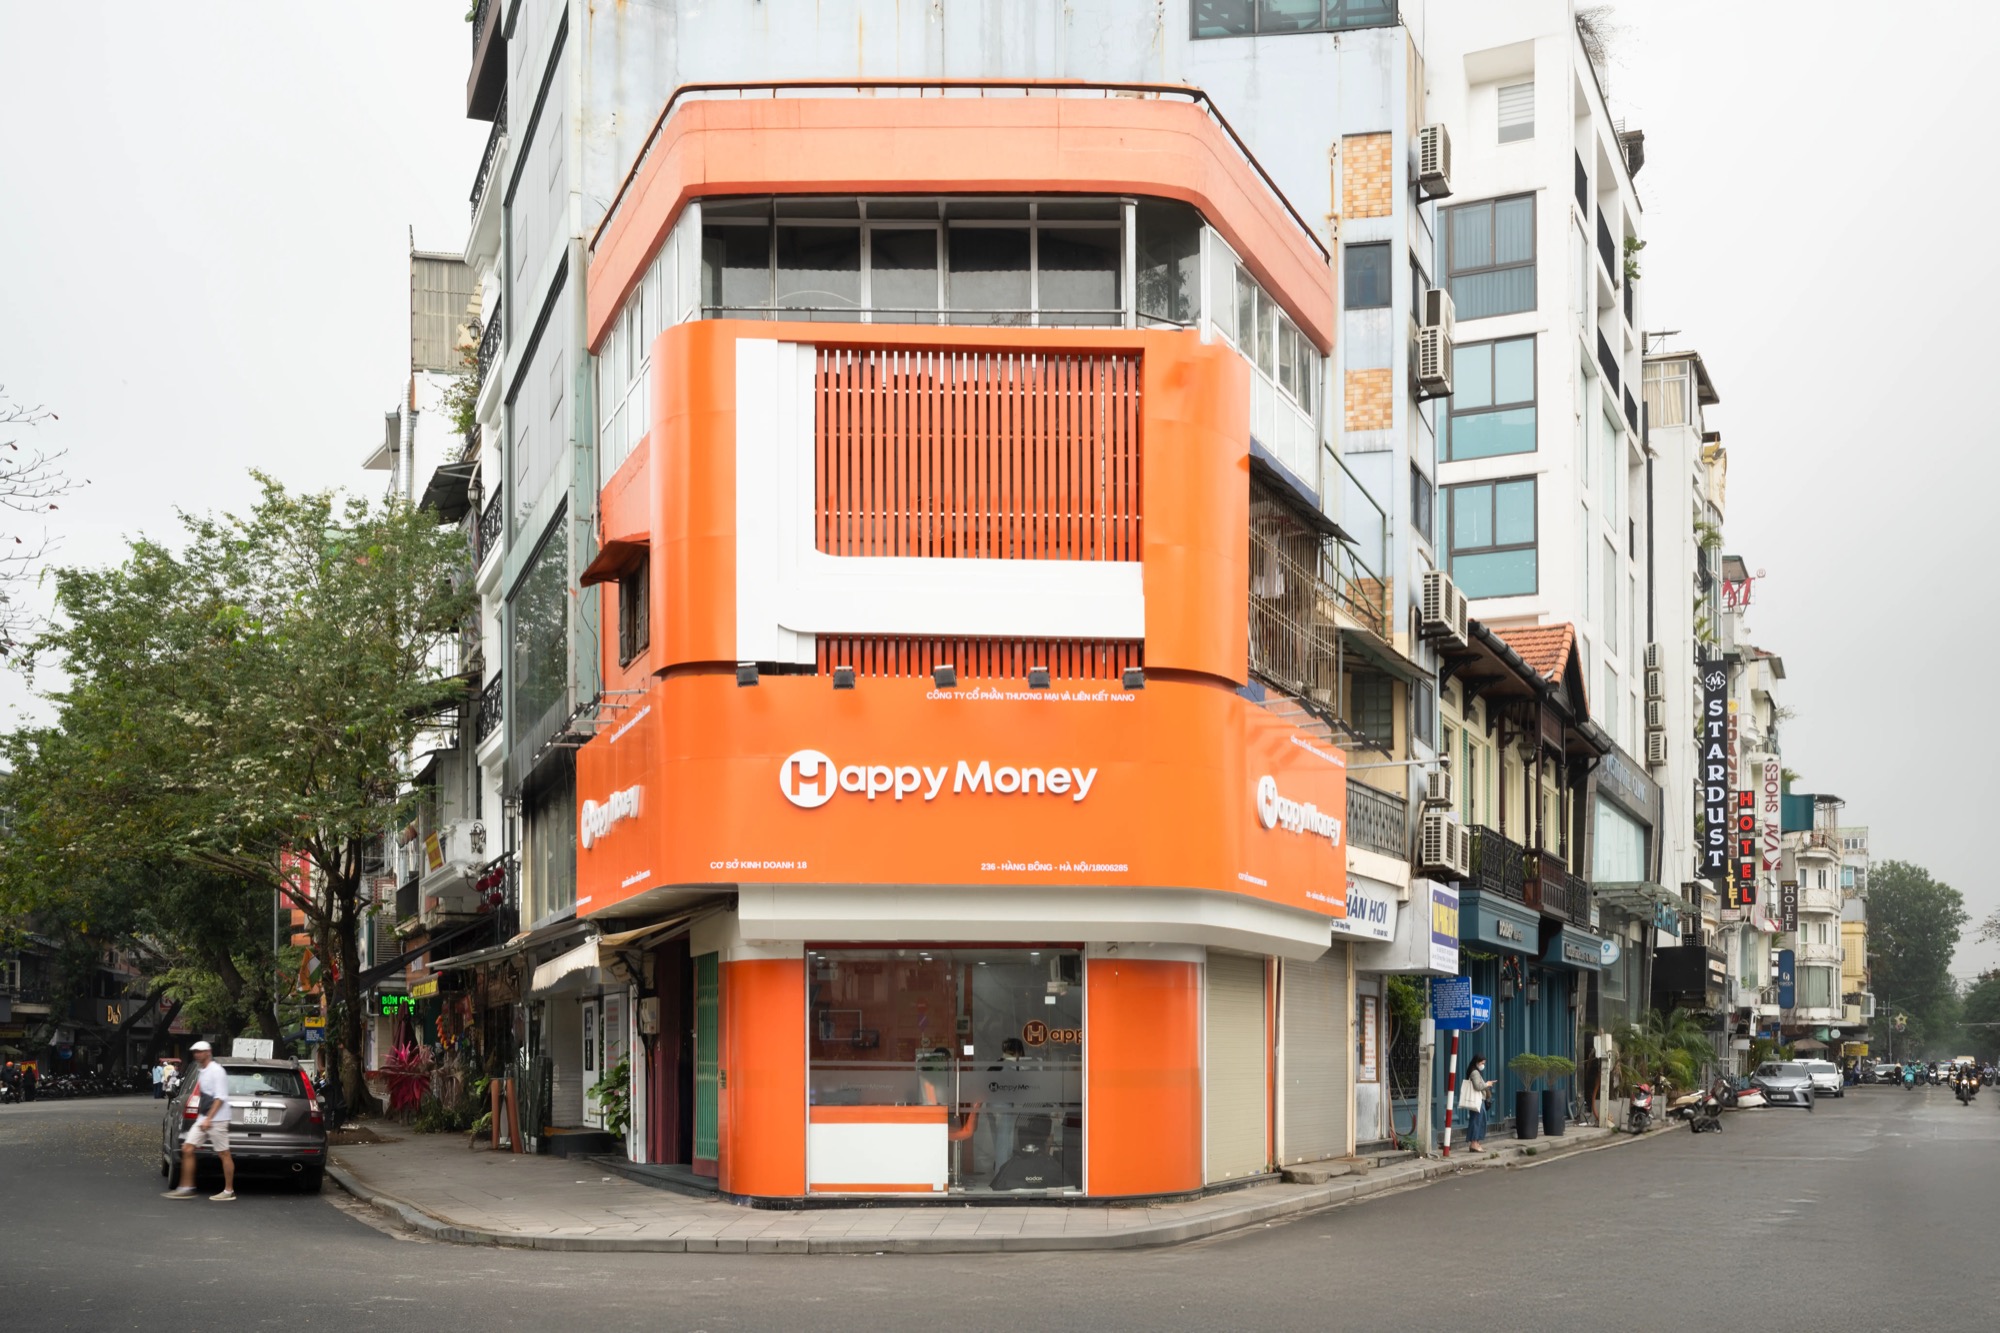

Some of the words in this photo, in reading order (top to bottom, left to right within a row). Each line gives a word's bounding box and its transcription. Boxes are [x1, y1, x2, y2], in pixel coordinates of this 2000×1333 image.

[926, 689, 952, 700] CÔNG
[954, 691, 965, 699] TY
[980, 687, 1004, 700] PHẦN
[1005, 691, 1042, 701] THƯƠNG
[1060, 690, 1071, 701] VÀ
[1072, 690, 1090, 701] LIÊN
[1092, 689, 1109, 702] KẾT
[1110, 693, 1135, 702] NANO
[779, 749, 948, 808] Happy
[954, 760, 1098, 801] Money
[1706, 699, 1726, 867] STARDUST
[1765, 763, 1779, 813] SHOES
[709, 861, 724, 870] CƠ
[725, 858, 739, 870] SỞ
[740, 861, 761, 869] KINH
[763, 861, 794, 869] DOANH
[797, 861, 808, 869] 18
[980, 862, 996, 871] 236
[1001, 860, 1026, 871] HÀNG
[1028, 860, 1053, 872] BÔNG
[1059, 861, 1072, 872] HÀ
[1740, 791, 1753, 903] HOTEL
[1368, 900, 1388, 925] HƠI
[1784, 885, 1795, 931] HOTEL
